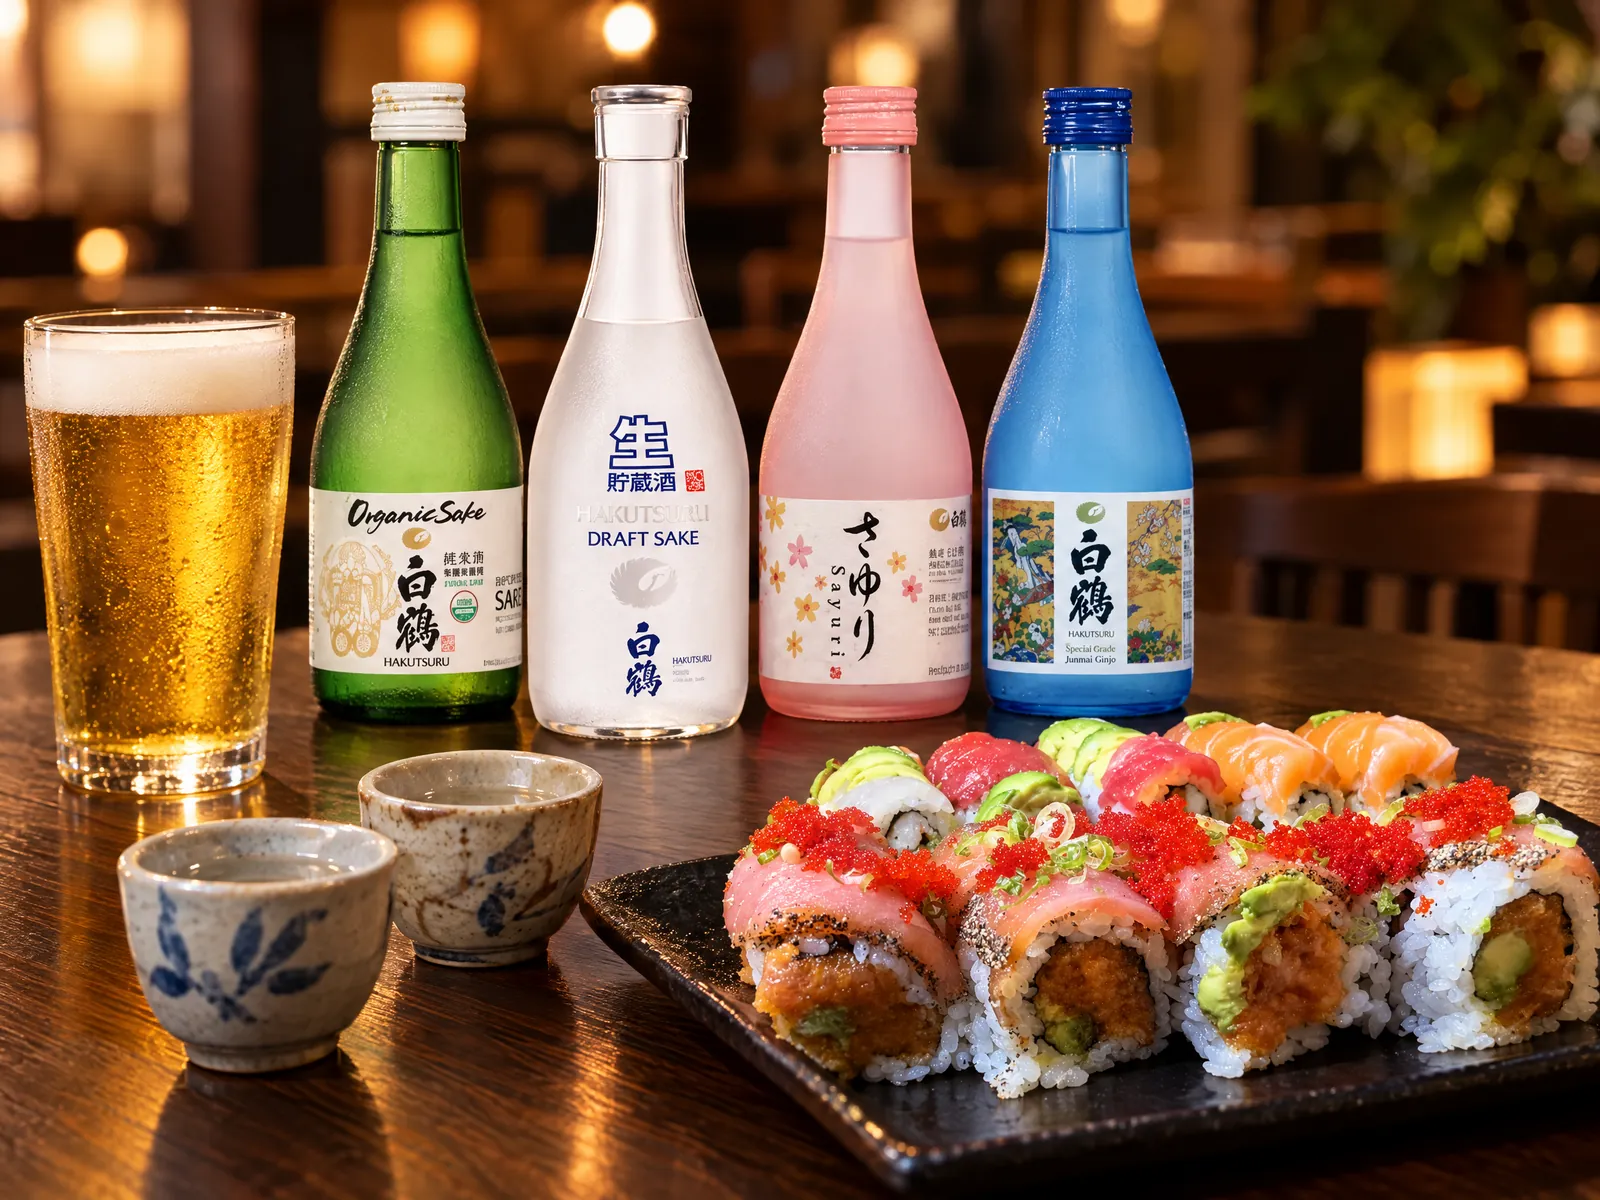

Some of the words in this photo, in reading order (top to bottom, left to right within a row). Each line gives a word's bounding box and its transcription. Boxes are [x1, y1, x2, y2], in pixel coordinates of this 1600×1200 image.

[609, 414, 675, 469] 生
[607, 472, 676, 492] 貯蔵酒
[348, 499, 437, 534] Organic
[434, 500, 487, 524] Sake
[577, 504, 710, 524] HAKUTSURU
[588, 531, 649, 546] DRAFT
[654, 530, 699, 546] SAKE
[843, 511, 881, 662] さゆり
[1069, 529, 1114, 626] 白鶴
[395, 555, 440, 653] 白鶴
[827, 565, 845, 657] Sayuri
[1068, 630, 1115, 638] HAKUTSURU
[625, 621, 662, 697] 白鶴
[1065, 644, 1092, 654] Special
[1093, 644, 1116, 653] Grade
[384, 658, 450, 667] HAKUTSURU
[672, 655, 712, 664] HAKUTSURU
[1065, 655, 1093, 664] Junmai
[1094, 655, 1117, 665] Ginjo
